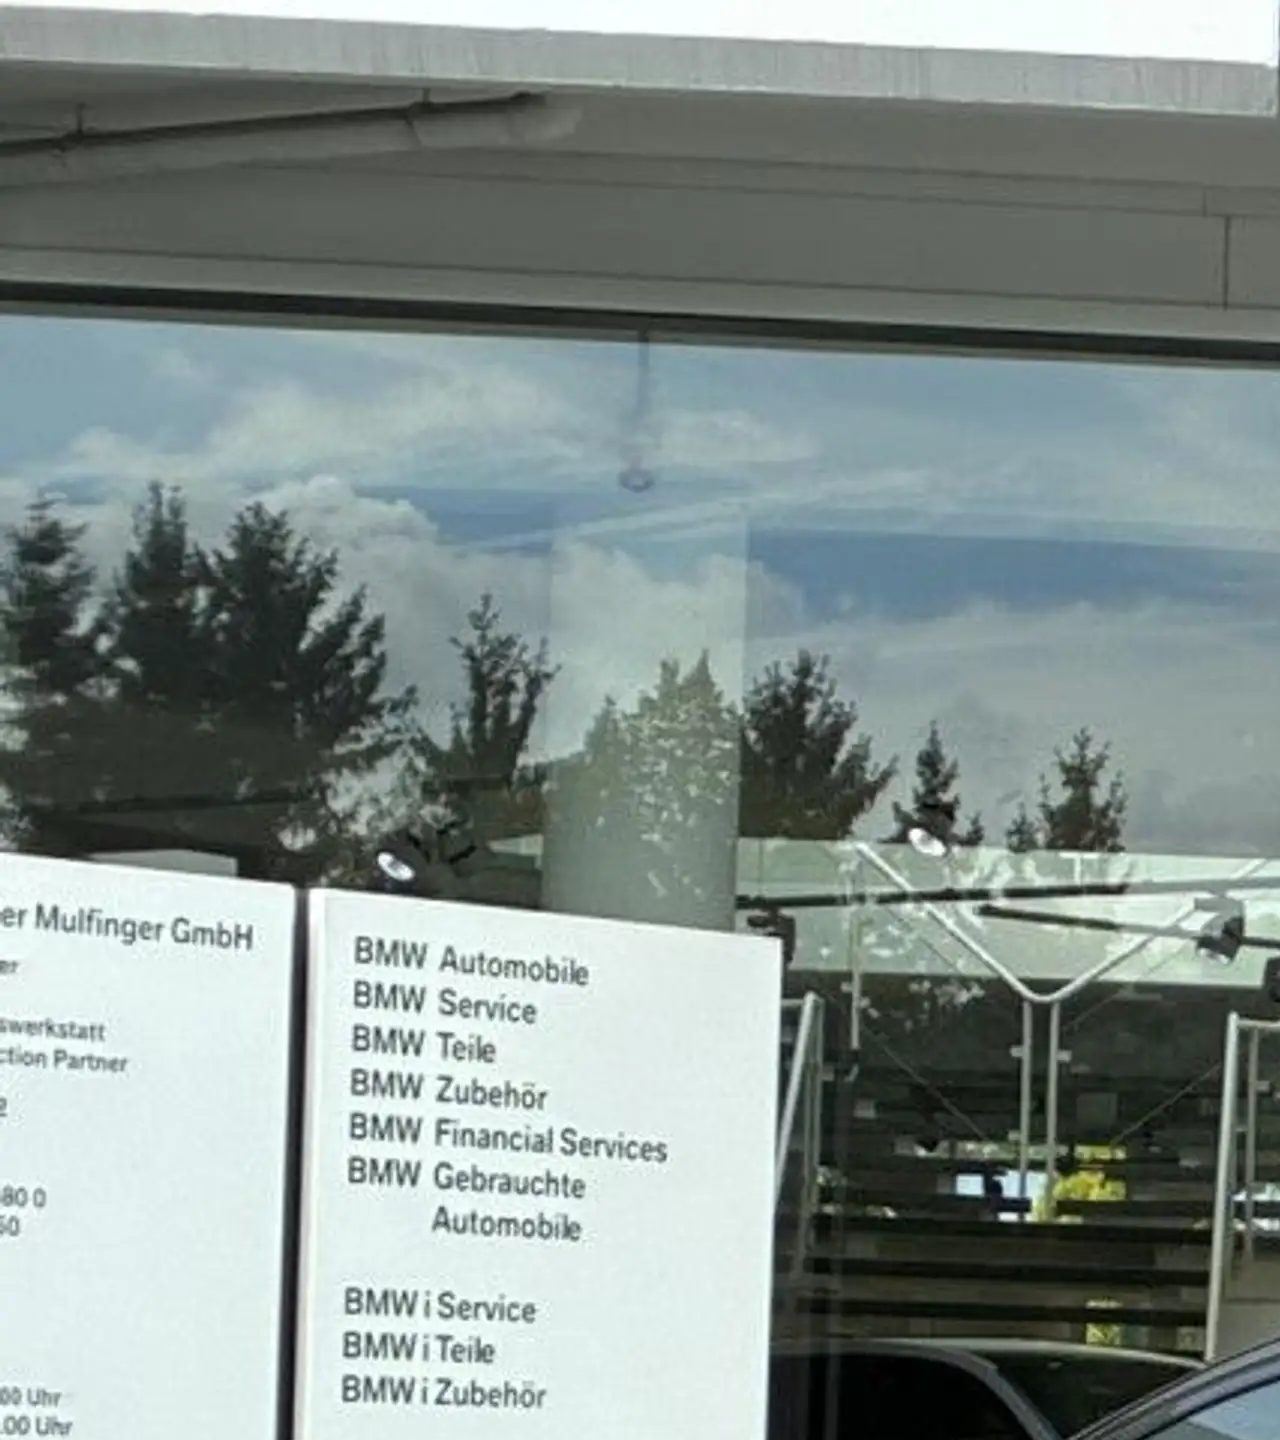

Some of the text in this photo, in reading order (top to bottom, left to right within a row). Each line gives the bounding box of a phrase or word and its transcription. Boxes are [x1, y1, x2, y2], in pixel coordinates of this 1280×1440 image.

[35, 902, 164, 946] Mulfinger
[171, 916, 254, 951] GmbH
[354, 935, 590, 987] BMW Automobile
[353, 979, 538, 1025] BMW Service
[53, 1048, 129, 1074] Partner
[351, 1023, 497, 1064] BMW Teile
[350, 1067, 549, 1111] BMW Zubehör
[348, 1112, 668, 1163] BMW Financial Services
[347, 1155, 587, 1199] BMW Gebrauchte
[431, 1205, 583, 1242] Automobile
[344, 1286, 538, 1325] BMW i Service
[342, 1330, 497, 1365] BMW i Teile
[27, 1387, 62, 1408] Uhr
[341, 1374, 548, 1409] BMW i Zubehör
[36, 1415, 73, 1437] Uhr
